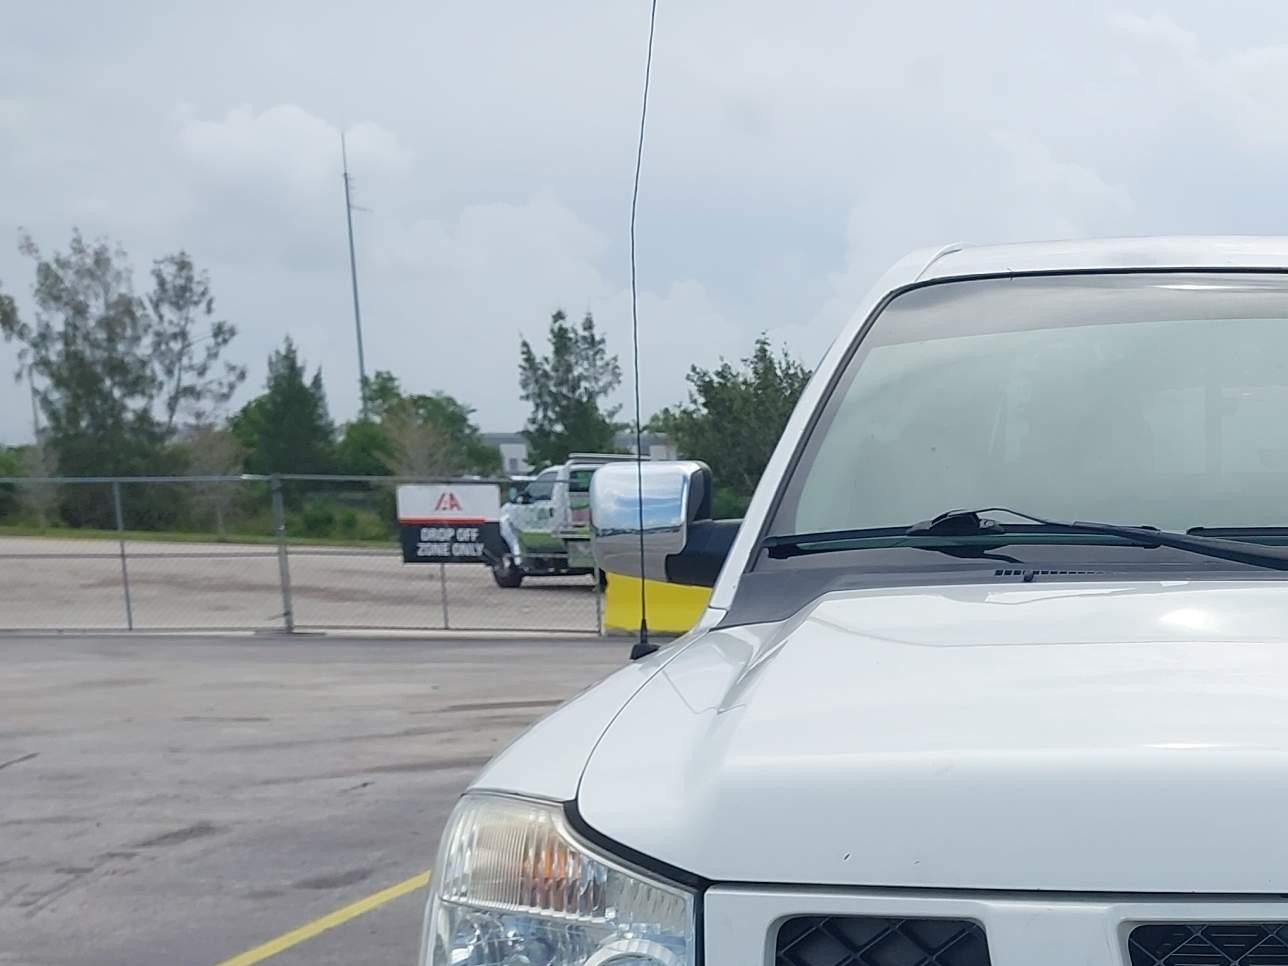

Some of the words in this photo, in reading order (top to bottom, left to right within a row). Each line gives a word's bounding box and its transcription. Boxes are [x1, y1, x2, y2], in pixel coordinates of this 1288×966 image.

[420, 527, 455, 542] DROP
[456, 527, 480, 542] OFF
[416, 542, 451, 557] ZONE
[451, 542, 485, 557] ONLY
